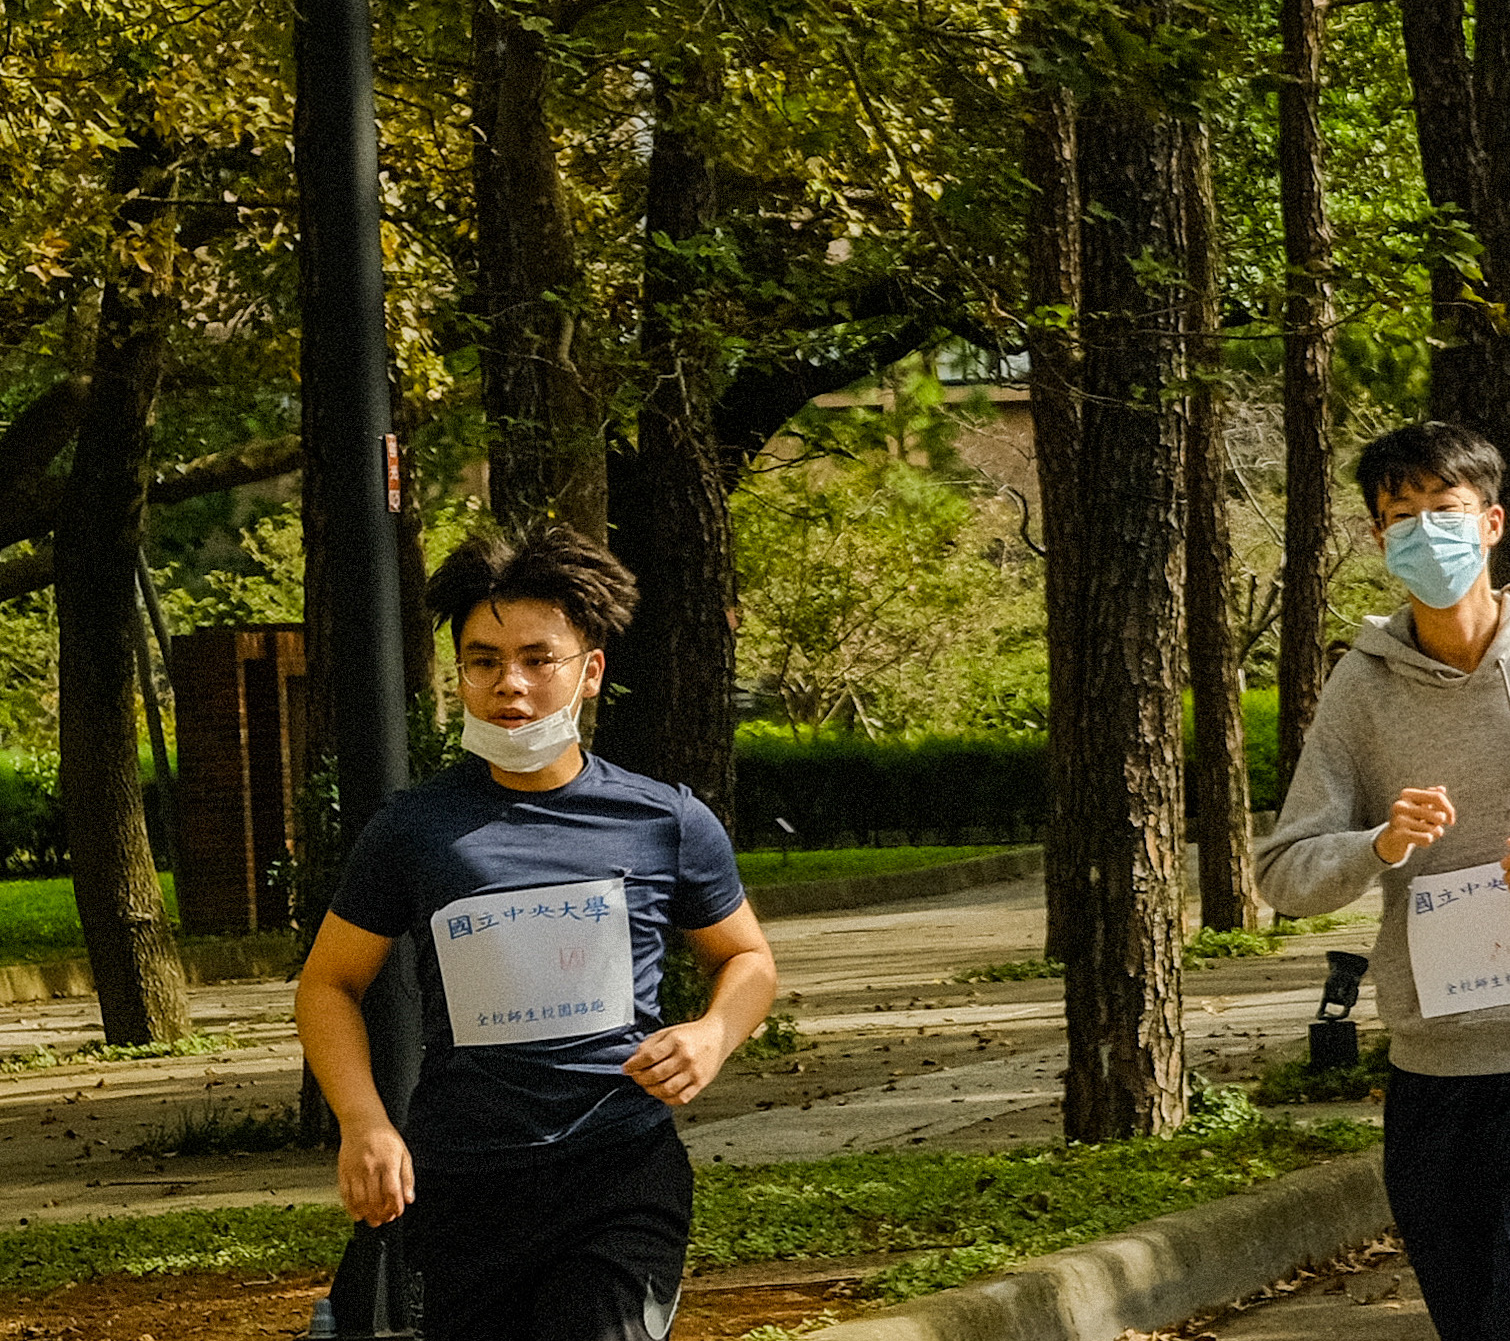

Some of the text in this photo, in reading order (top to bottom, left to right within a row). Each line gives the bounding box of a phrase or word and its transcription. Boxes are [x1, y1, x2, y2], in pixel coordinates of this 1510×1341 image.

[1415, 878, 1508, 915] 國立中央
[447, 895, 610, 940] 國立中央大學
[476, 998, 606, 1027] 全校師生校園路跑
